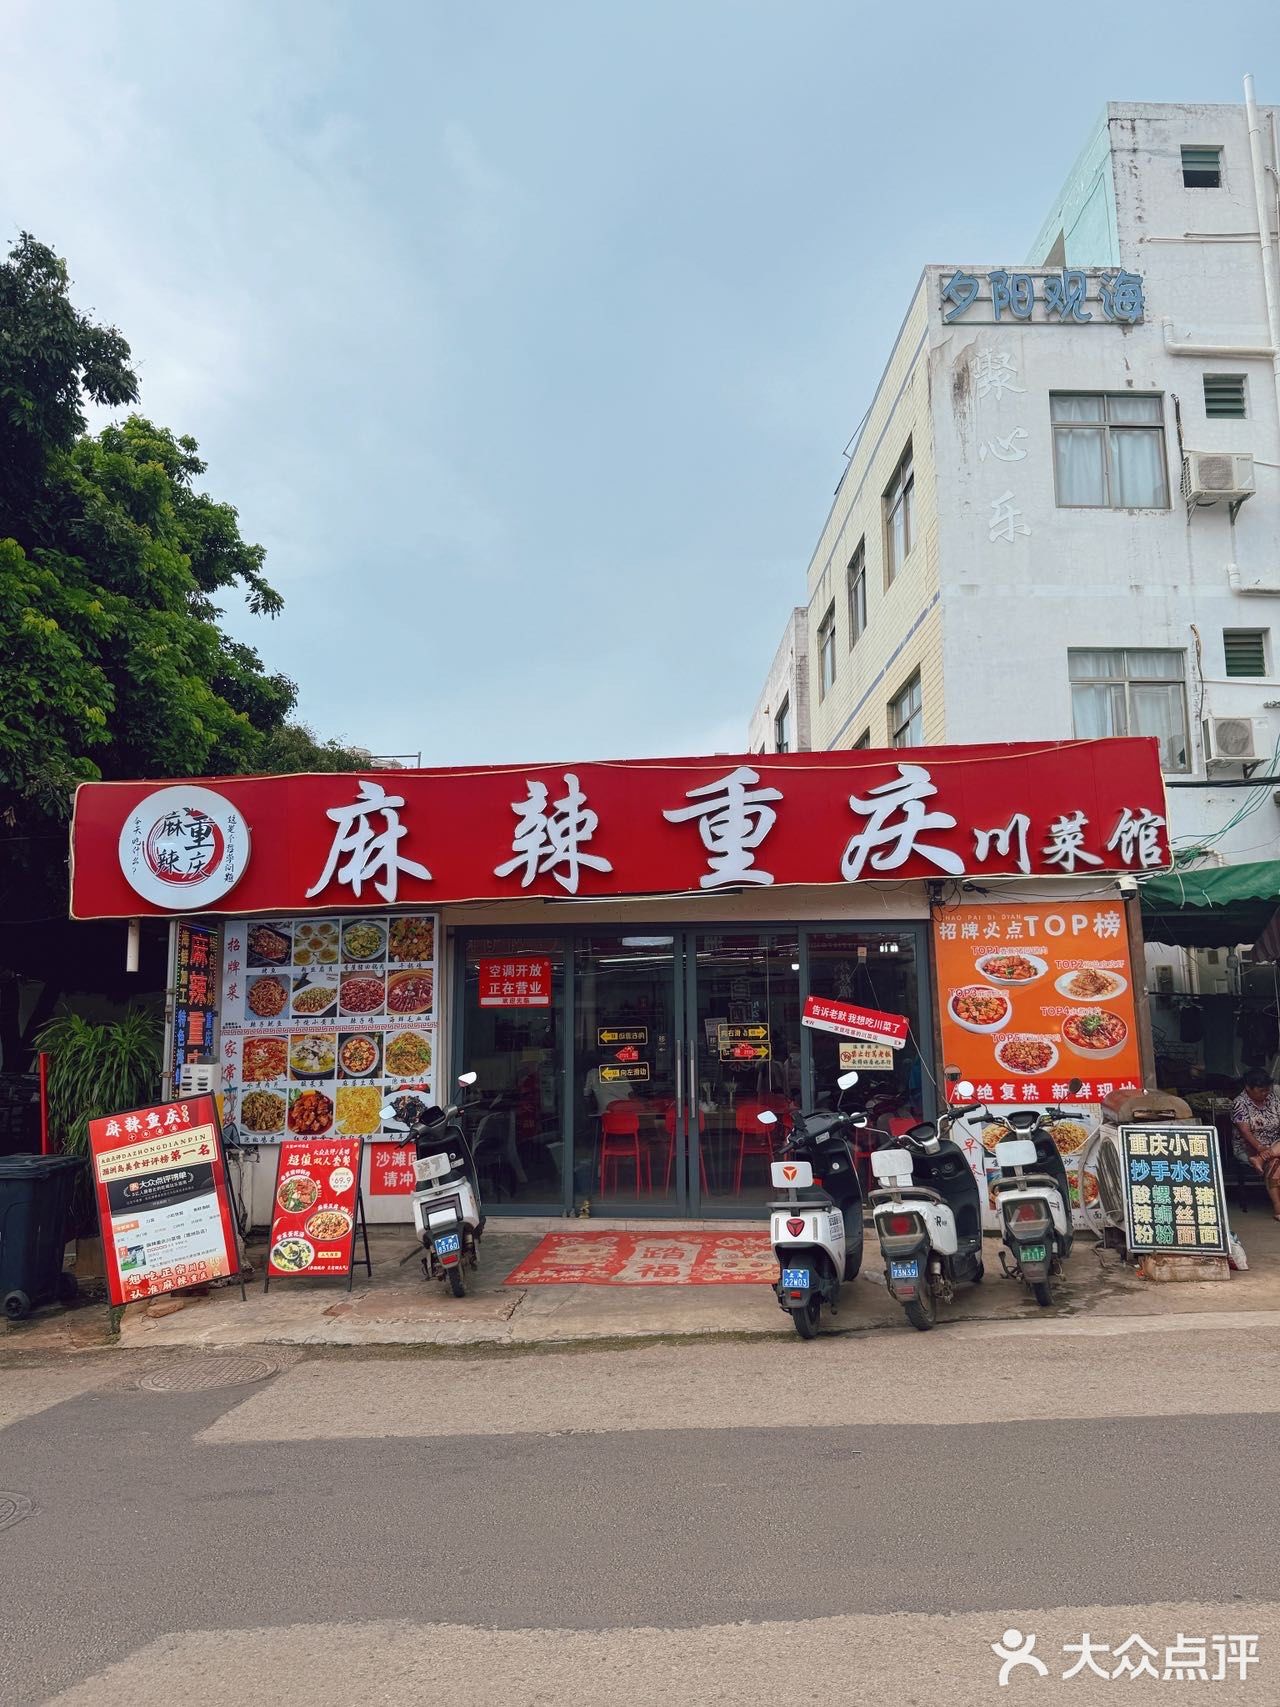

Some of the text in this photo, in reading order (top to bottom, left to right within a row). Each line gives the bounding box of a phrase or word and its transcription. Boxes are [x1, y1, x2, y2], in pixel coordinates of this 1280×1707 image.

[941, 269, 1146, 323] 夕阳观海
[305, 764, 1167, 902] 麻辣重庆 川菜馆
[226, 936, 241, 1001] 招牌菜
[489, 963, 542, 978] 空调开放
[488, 981, 542, 995] 正在营业
[812, 1004, 900, 1034] 告诉老默 我想吃川菜了
[105, 1108, 182, 1138] 麻辣重庆
[1128, 1133, 1209, 1157] 重庆小面
[287, 1153, 351, 1167] 超值 双人套餐
[1130, 1159, 1211, 1182] 抄手水饺
[383, 1170, 417, 1187] 请冲
[1131, 1185, 1154, 1244] 酸辣粉
[1172, 1185, 1197, 1245] 鸡丝面
[1194, 1186, 1219, 1245] 猪脚面
[128, 1260, 207, 1286] 想吃正宗川菜
[130, 1271, 209, 1300] 认准麻辣重庆
